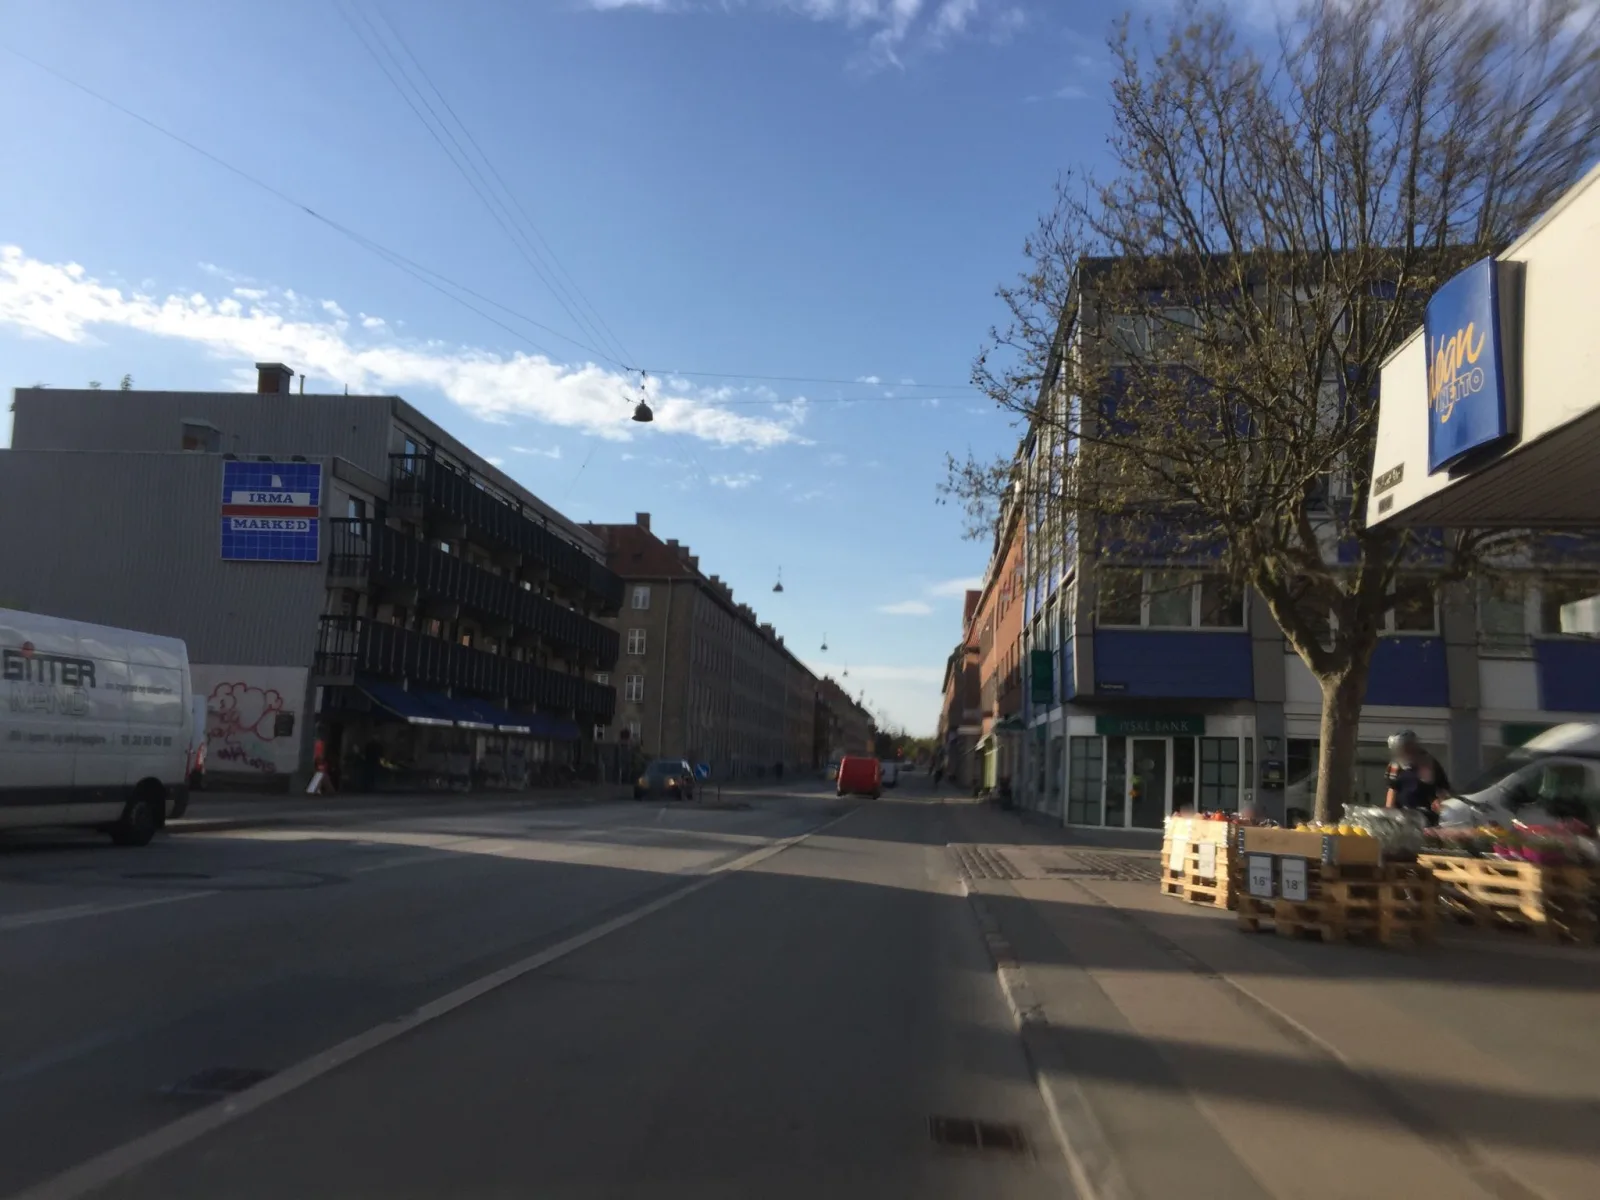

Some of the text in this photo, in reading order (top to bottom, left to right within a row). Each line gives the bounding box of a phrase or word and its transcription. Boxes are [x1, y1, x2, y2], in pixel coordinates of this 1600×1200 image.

[1436, 367, 1484, 413] NETTO
[248, 493, 294, 504] IRMA
[233, 519, 307, 530] MARKED
[3, 648, 96, 688] GITTER
[1155, 719, 1190, 732] BANK
